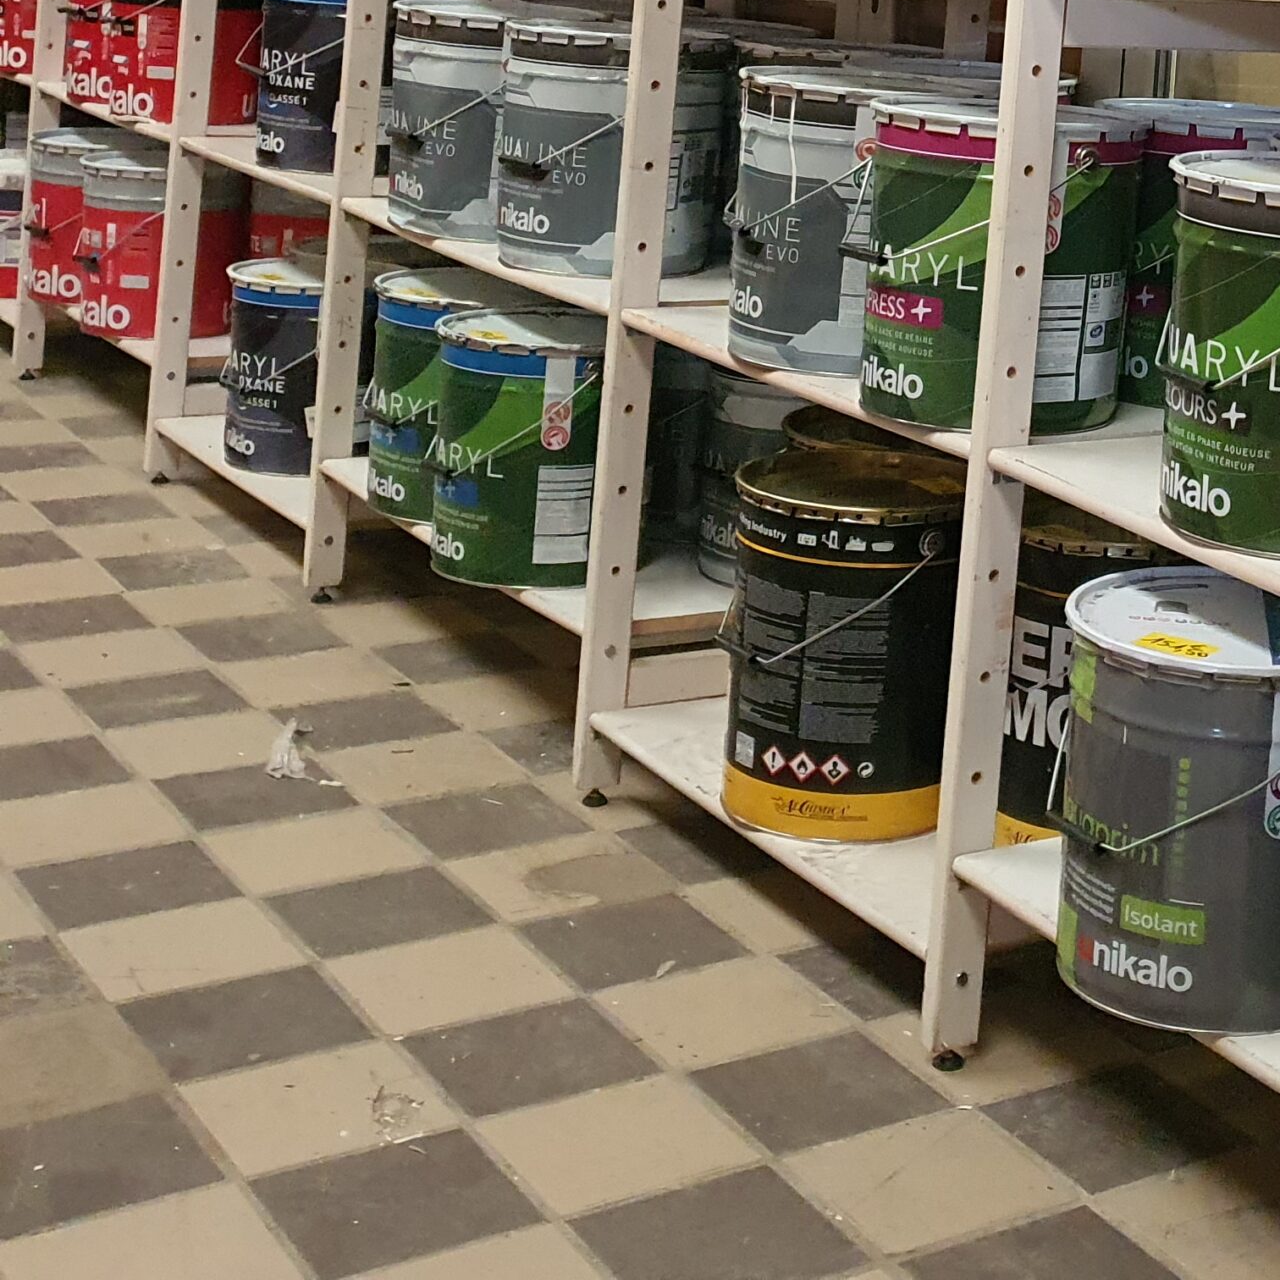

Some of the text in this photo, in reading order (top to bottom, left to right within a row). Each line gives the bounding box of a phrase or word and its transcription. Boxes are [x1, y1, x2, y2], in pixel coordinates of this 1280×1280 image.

[269, 73, 315, 90] OXANE
[425, 143, 456, 158] EVO
[552, 171, 587, 186] EVO
[766, 244, 799, 263] EVO
[1224, 443, 1271, 459] AQUEUSE
[1124, 905, 1198, 937] Isolant
